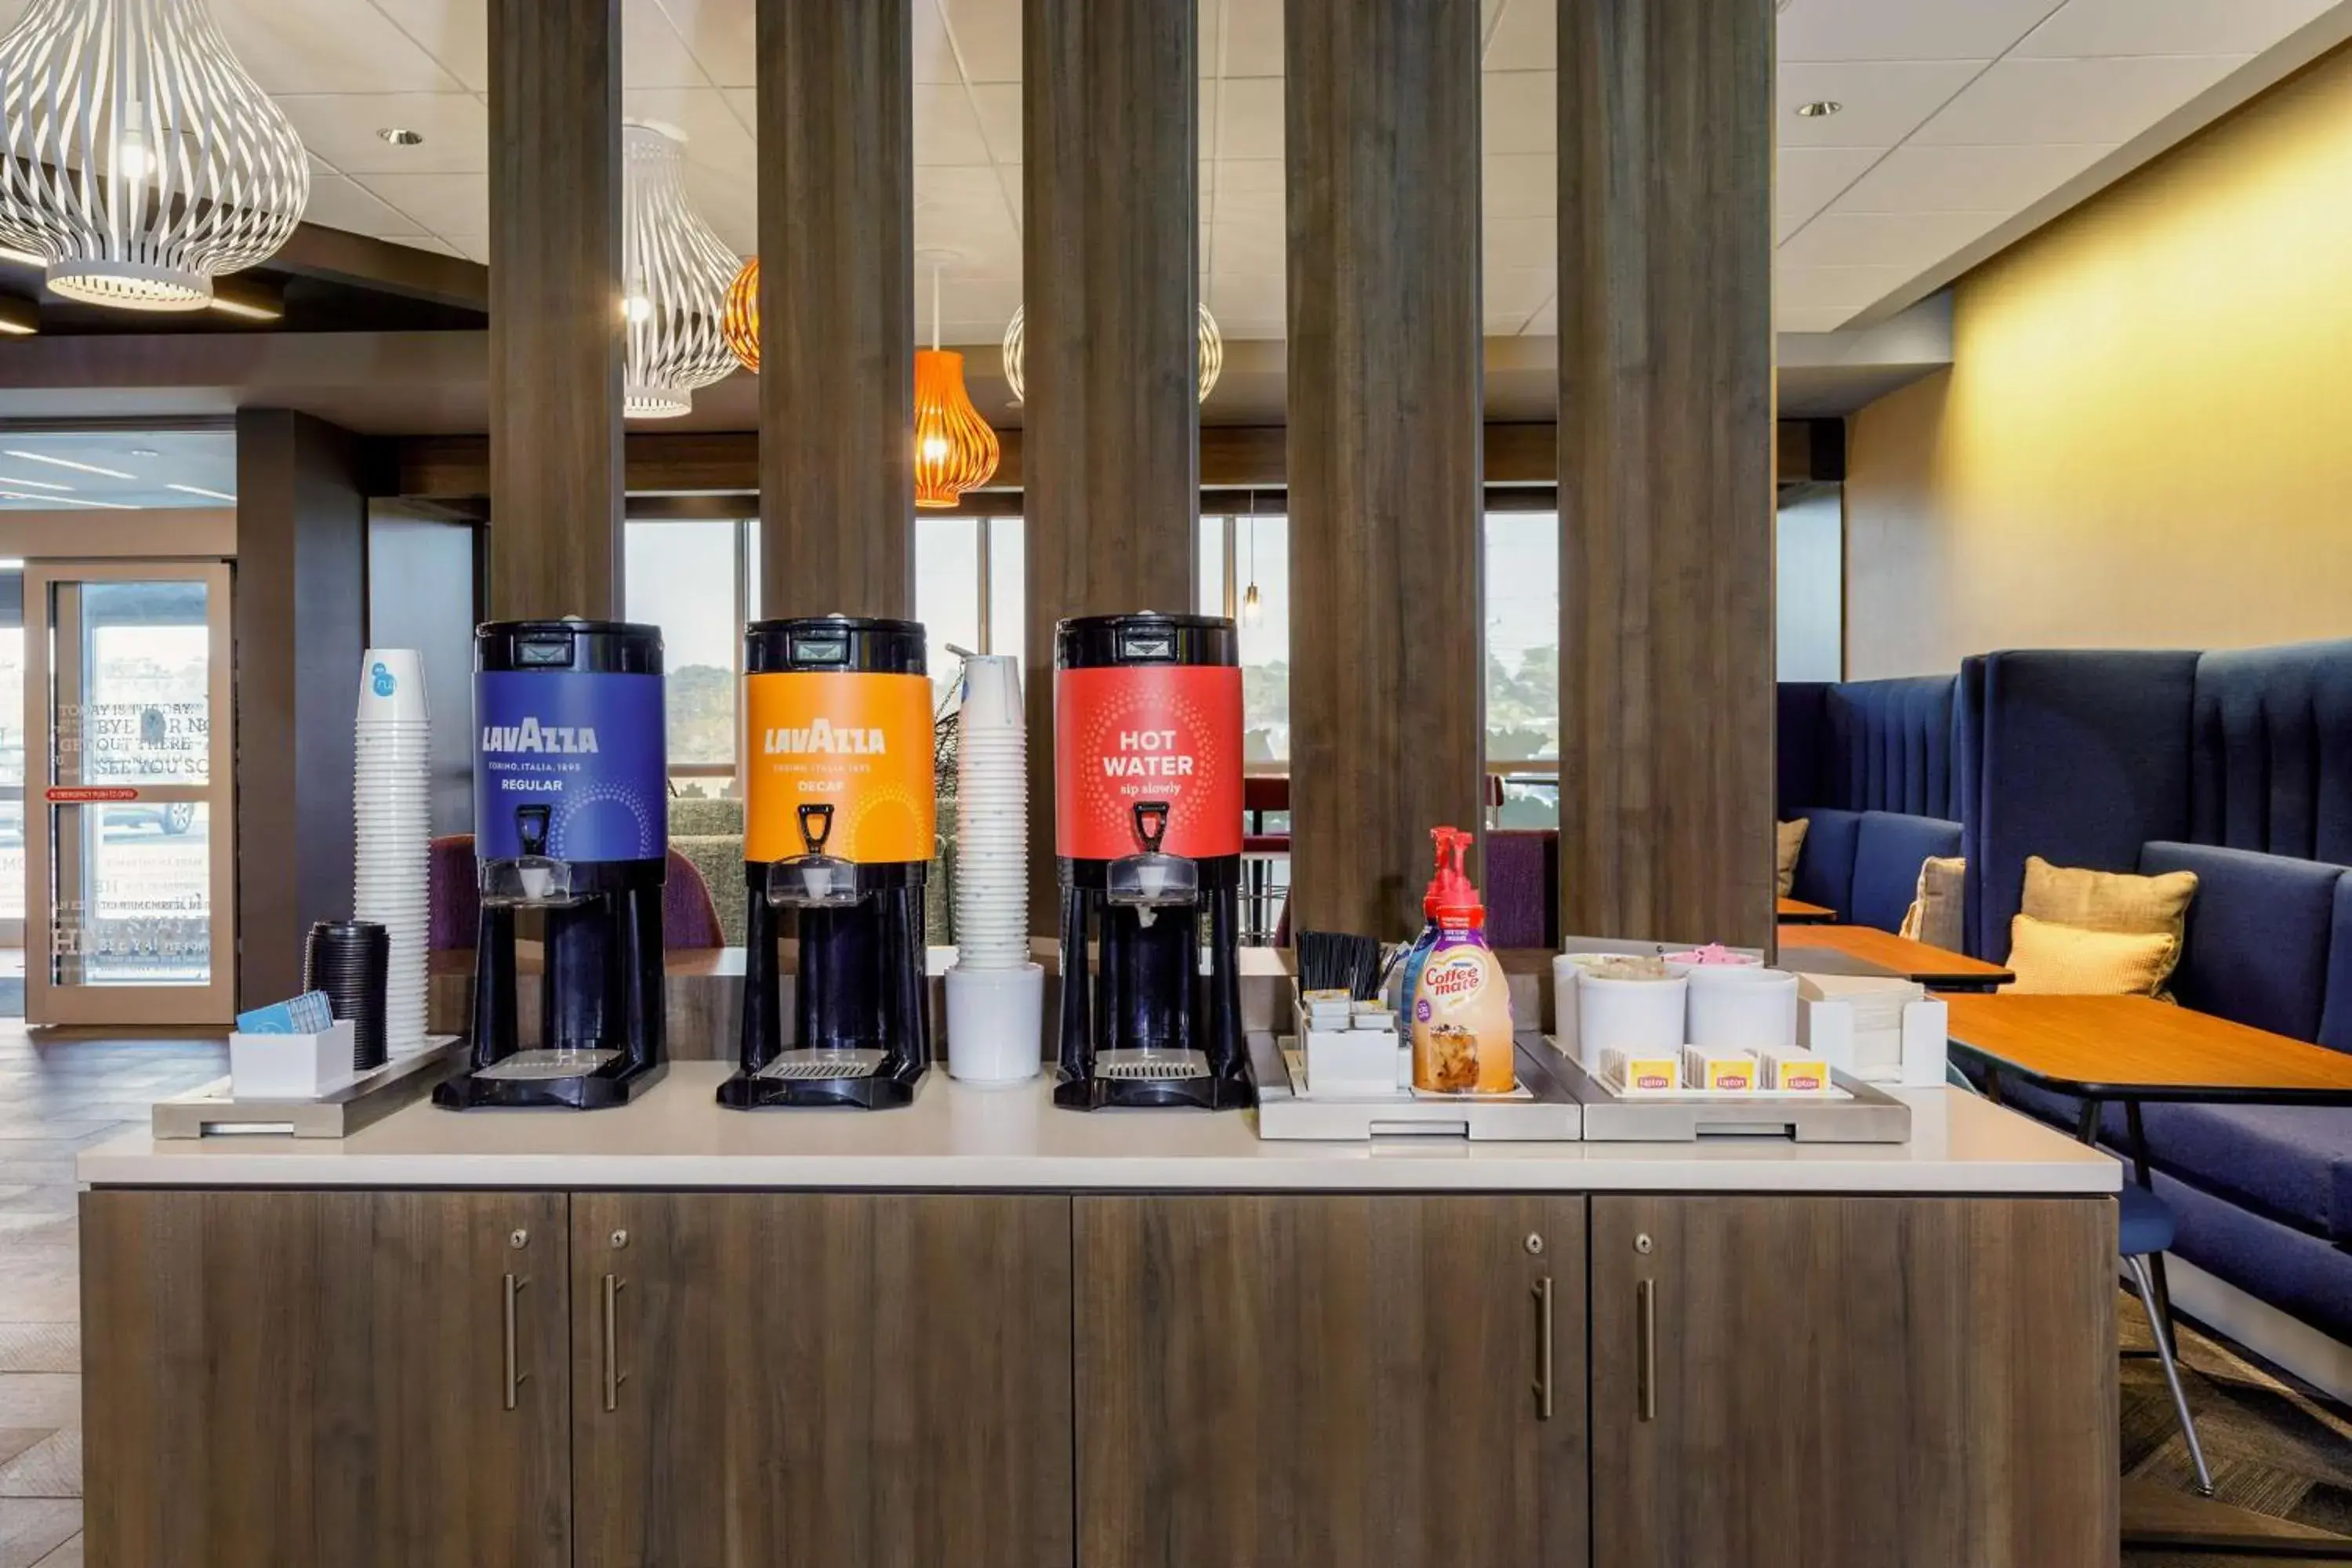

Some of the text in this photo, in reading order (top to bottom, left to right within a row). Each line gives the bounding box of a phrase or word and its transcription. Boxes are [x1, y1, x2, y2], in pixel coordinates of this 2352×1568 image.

[97, 719, 134, 735] BYE
[482, 717, 599, 753] LAVAZZA
[764, 717, 886, 754] LAVAZZA
[1120, 730, 1176, 751] HOT
[96, 738, 132, 751] OUT
[1103, 756, 1193, 778] WATER
[502, 779, 563, 791] REGULAR
[798, 780, 844, 792] DECAF
[1120, 781, 1181, 797] sip slowly
[1426, 967, 1478, 985] Coffee
[1436, 978, 1479, 996] mate
[1639, 1078, 1666, 1088] Lipton
[1719, 1078, 1744, 1087] Lipton
[1789, 1080, 1817, 1089] Lipton
